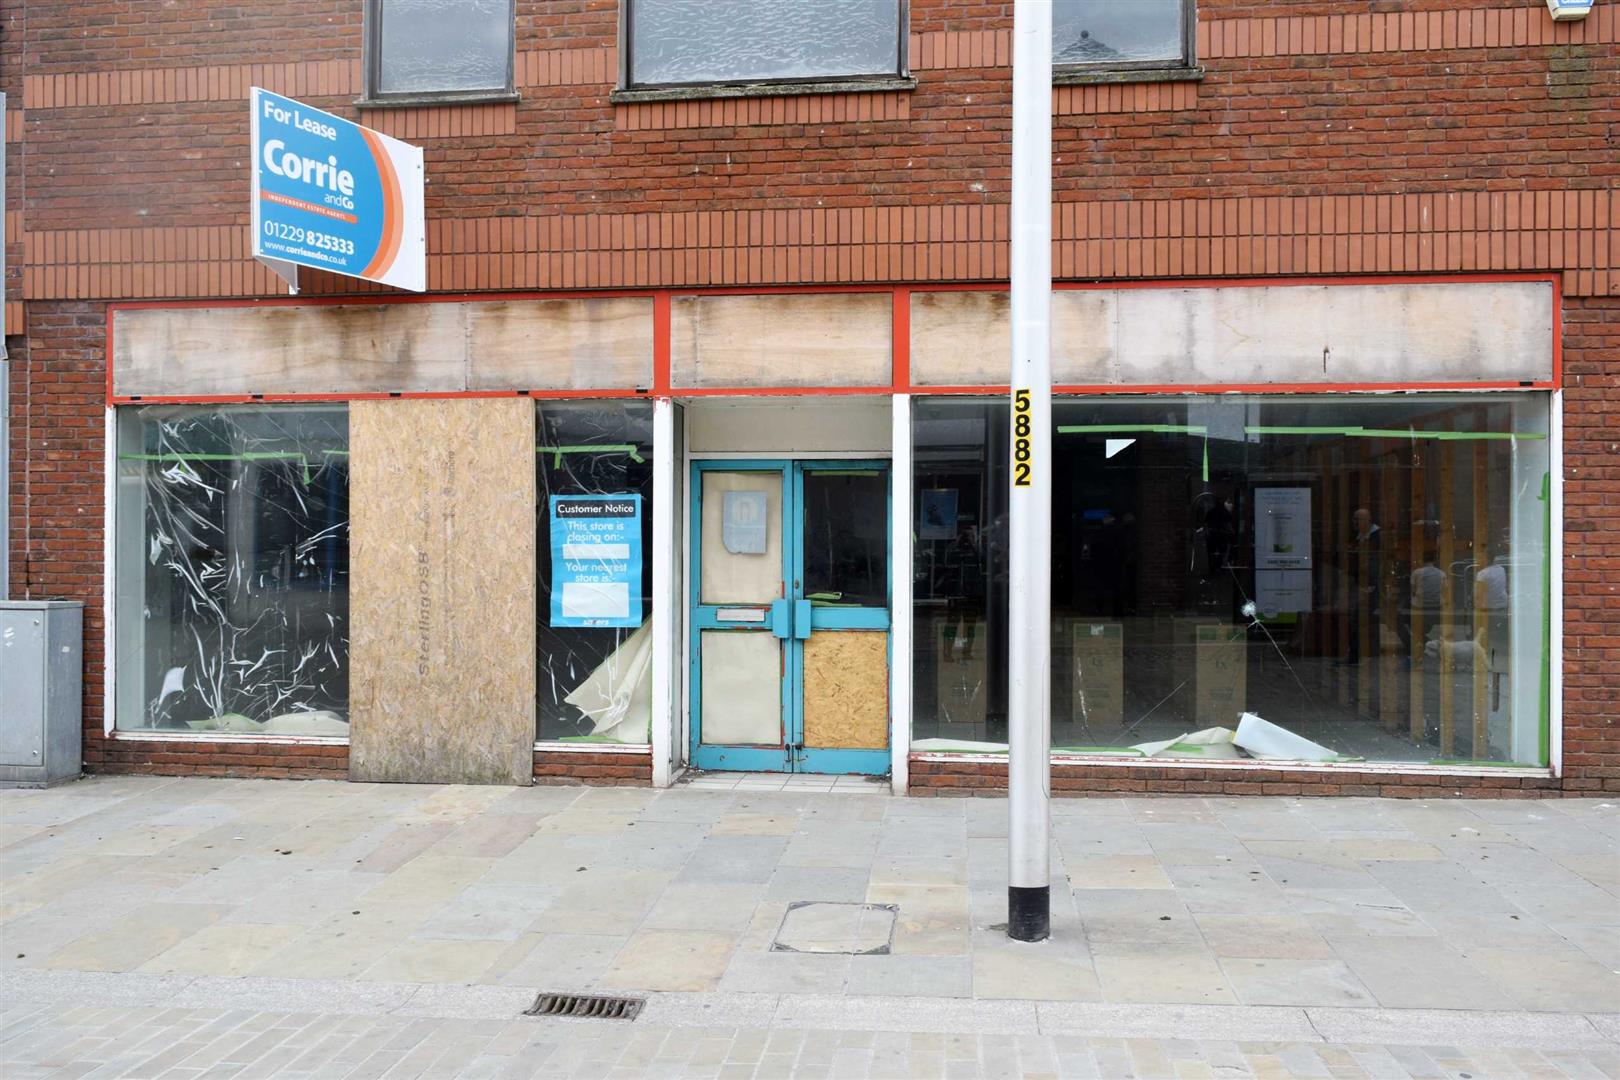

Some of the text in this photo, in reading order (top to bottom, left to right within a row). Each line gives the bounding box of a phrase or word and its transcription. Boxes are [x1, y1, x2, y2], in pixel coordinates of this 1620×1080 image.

[264, 100, 337, 141] For Lease
[263, 139, 355, 196] Corrie
[267, 194, 346, 220] INDEPENDENT ESTATE AGENTS
[264, 220, 354, 255] 01229 825333
[264, 241, 348, 265] www.corrieandco.co.uk
[557, 503, 634, 513] Customer Notice
[567, 520, 624, 531] This store is
[567, 532, 601, 544] closing
[565, 562, 627, 572] Your nearest
[575, 574, 599, 582] store
